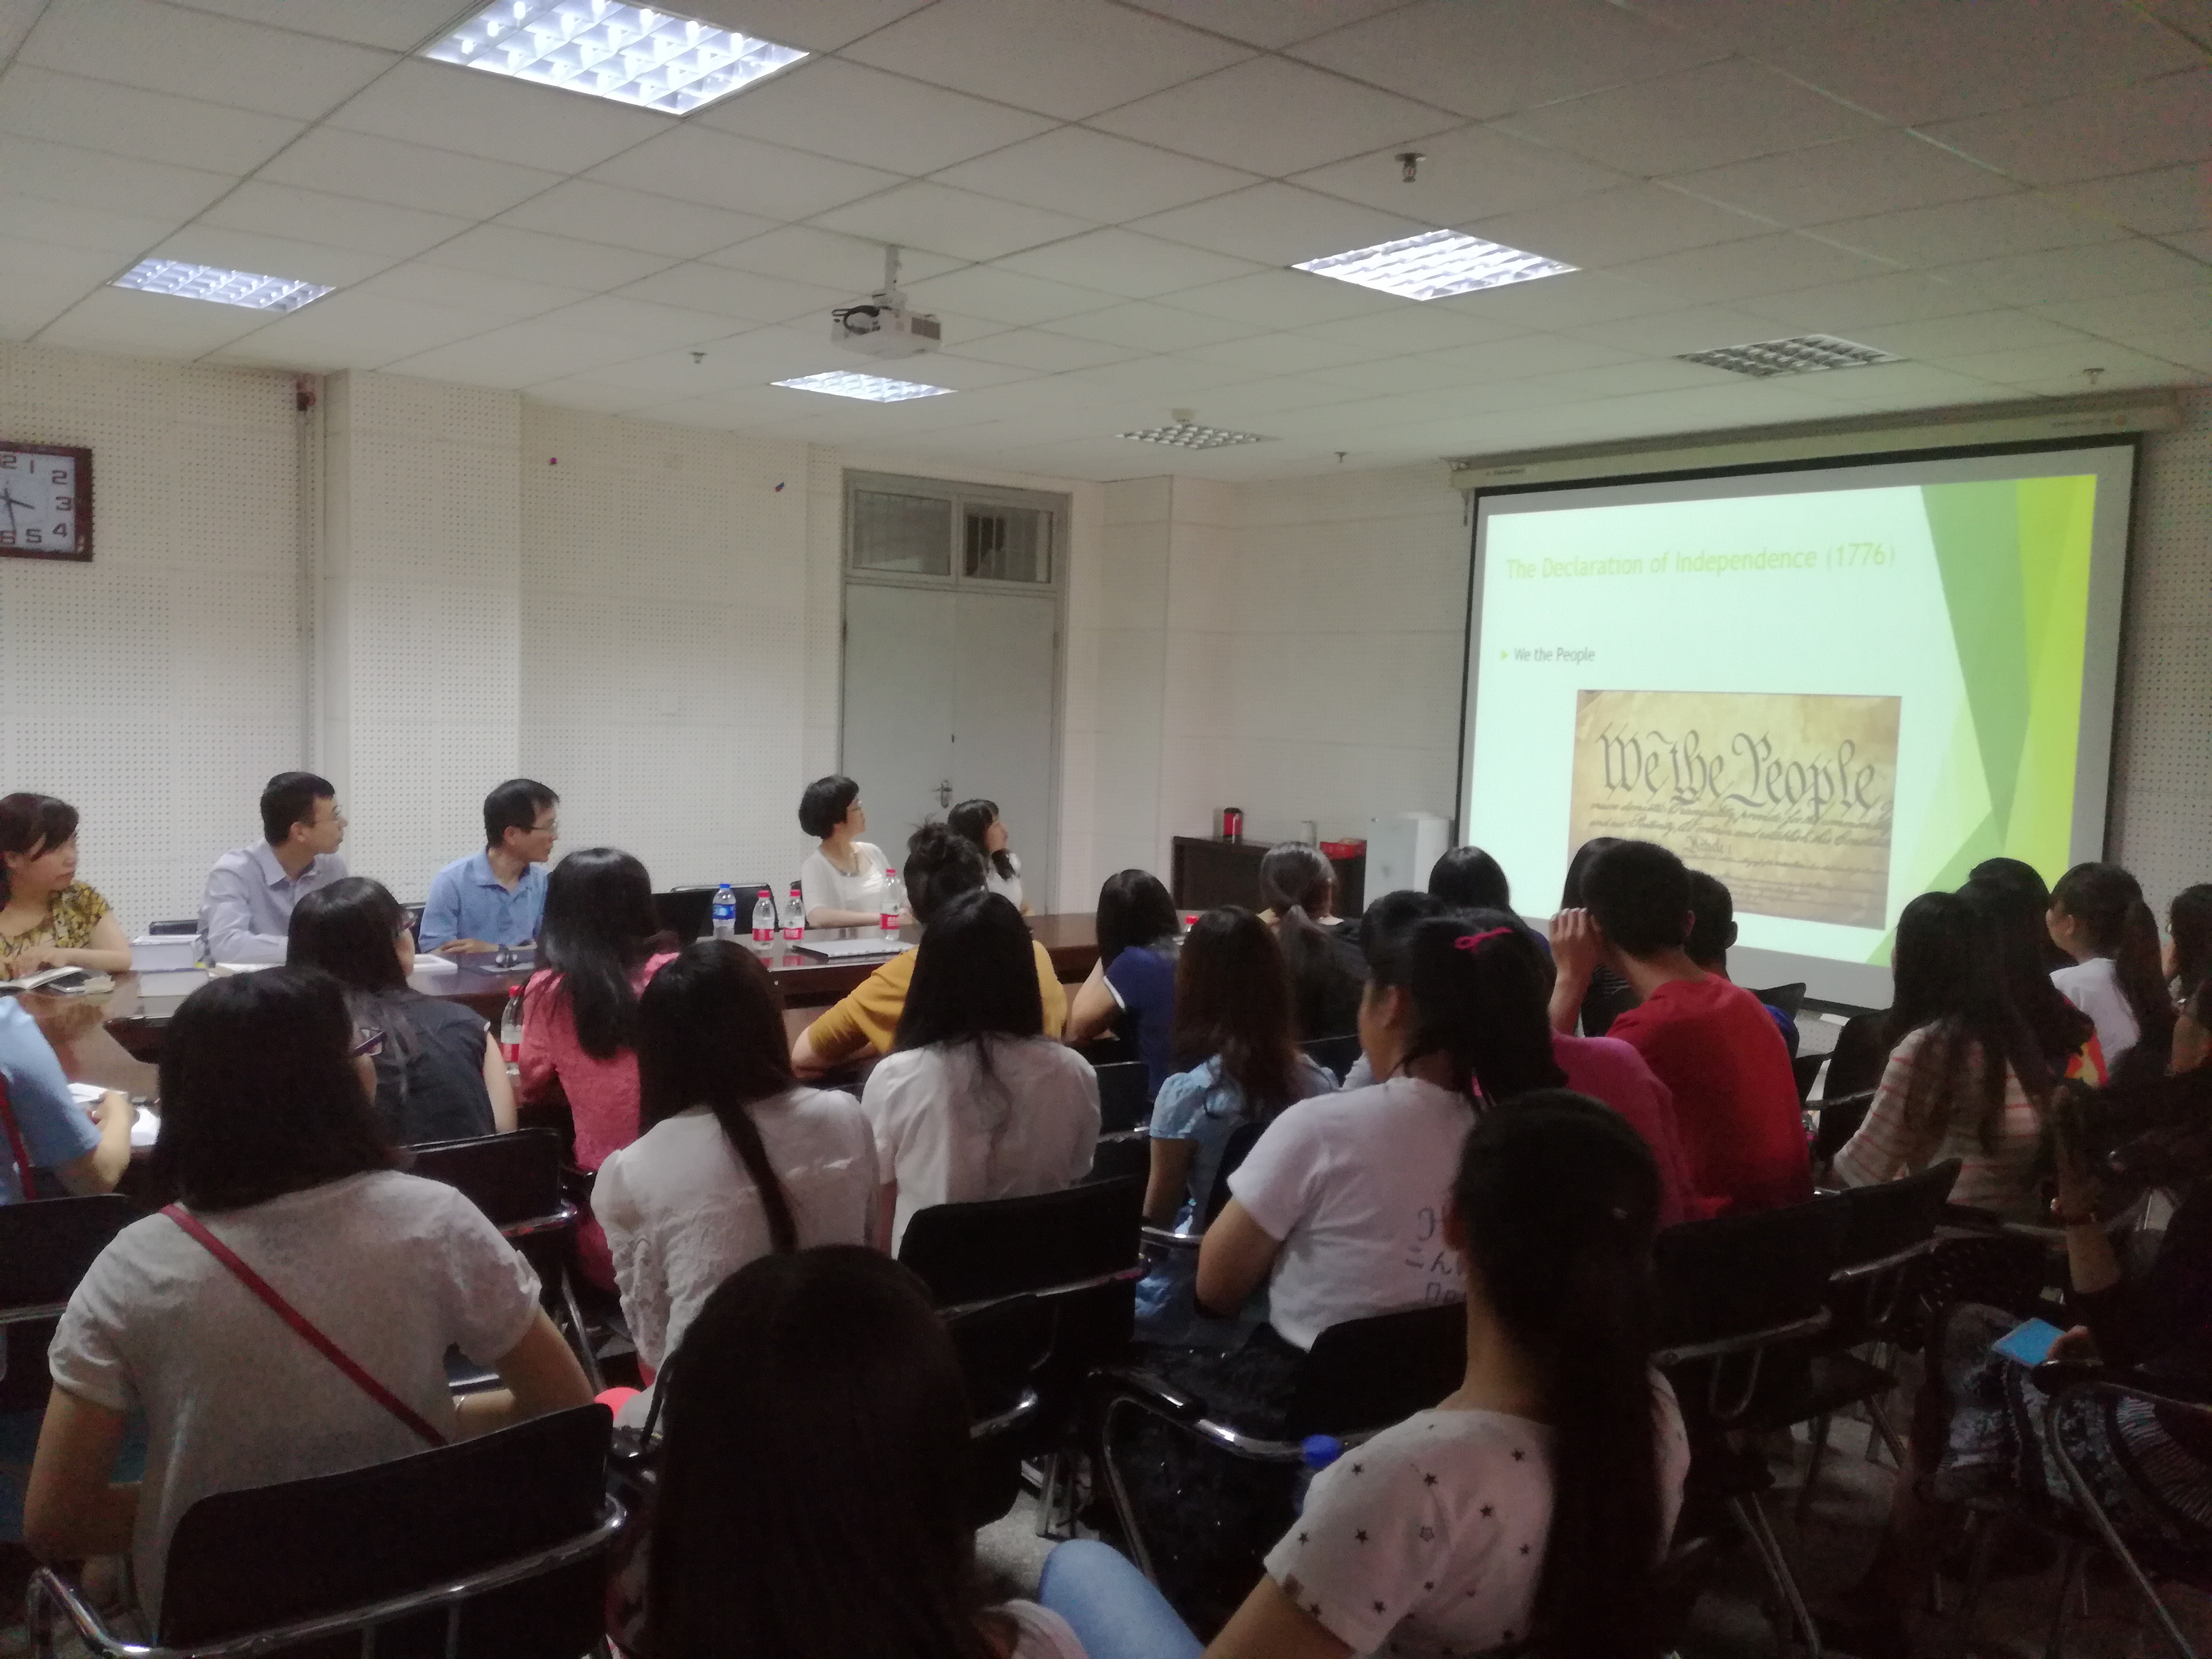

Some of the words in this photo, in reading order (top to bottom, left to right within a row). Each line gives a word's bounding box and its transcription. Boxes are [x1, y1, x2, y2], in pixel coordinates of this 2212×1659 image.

[52, 470, 67, 485] 2
[55, 496, 72, 511] 3
[26, 529, 42, 543] 5
[53, 523, 67, 538] 4
[1506, 559, 1536, 579] The
[1543, 555, 1643, 578] Declaration
[1650, 551, 1670, 573] of
[1675, 548, 1816, 576] Independence
[1826, 543, 1895, 571] (1776)
[1514, 648, 1531, 662] We
[1534, 647, 1553, 662] the
[1557, 646, 1596, 666] People
[1597, 723, 1669, 801] We
[1725, 731, 1889, 825] People
